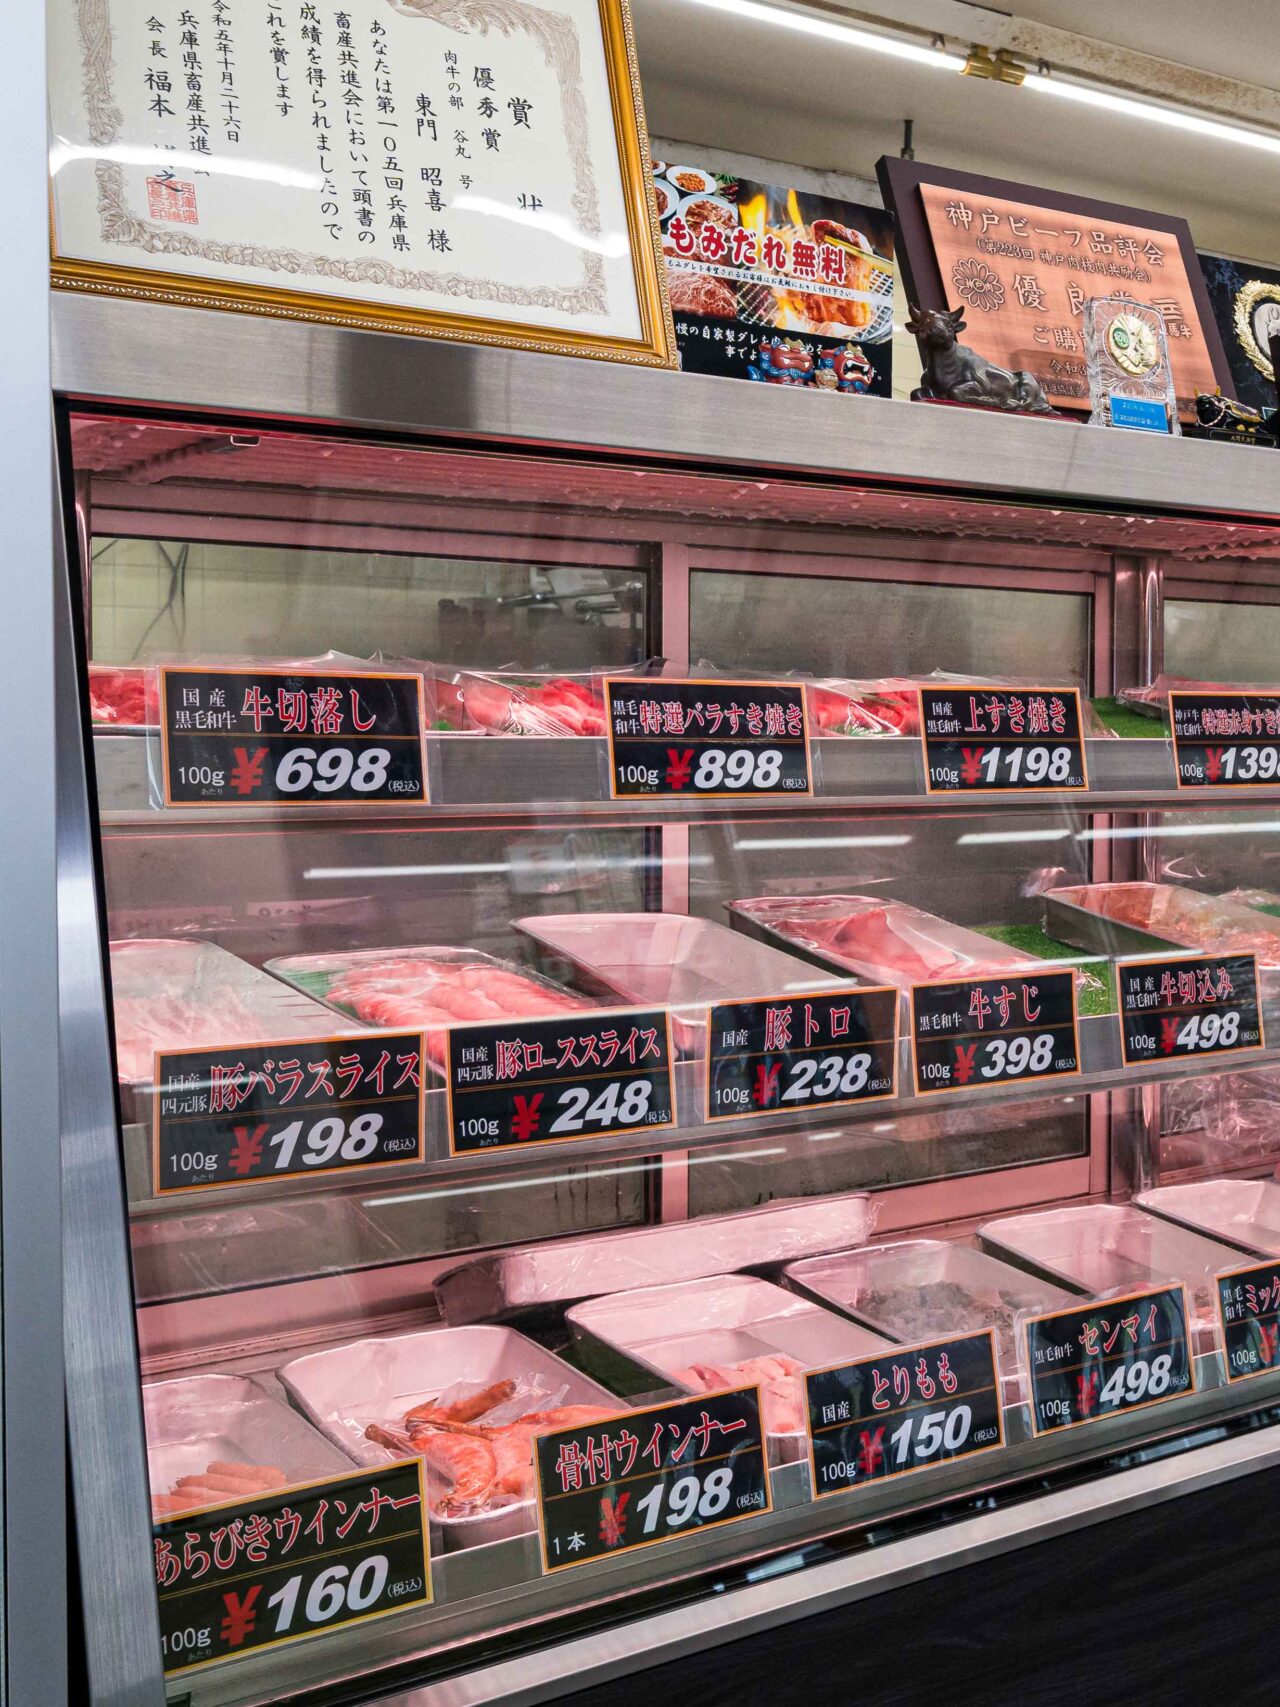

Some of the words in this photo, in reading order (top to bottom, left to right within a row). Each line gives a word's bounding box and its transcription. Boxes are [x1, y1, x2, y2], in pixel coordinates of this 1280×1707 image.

[145, 16, 167, 59] 会長
[212, 0, 241, 143] 令和五年十月二十六日
[445, 51, 464, 110] 肉牛の部
[144, 68, 176, 118] 福本
[415, 93, 438, 141] 東門
[473, 67, 501, 152] 優秀賞
[334, 11, 375, 244] 畜産共進会において頭書の
[421, 167, 447, 212] 昭喜
[427, 229, 453, 252] 様
[945, 201, 1165, 266] 神戸ビーフ品評会
[668, 217, 846, 283] もみだれ無料
[183, 688, 226, 707] 国産
[613, 700, 638, 715] 黒毛
[241, 686, 377, 734] 牛切落し
[640, 700, 803, 735] 特選バラすき焼き
[932, 702, 953, 716] 国産
[965, 697, 1066, 733] 上すき焼き
[175, 710, 237, 729] 黒毛和牛
[615, 719, 640, 735] 和牛
[928, 720, 961, 733] 黒毛和牛
[1176, 724, 1203, 736] 黒毛和牛
[179, 766, 225, 786] 100g
[618, 766, 659, 784] 100g
[1180, 764, 1203, 778] 100g
[1130, 977, 1154, 992] 国産
[1160, 966, 1233, 1006] 牛切込み
[968, 985, 1041, 1030] 牛すじ
[1127, 991, 1160, 1008] 黒毛和牛
[764, 1004, 850, 1051] 豚トロ
[920, 1012, 962, 1031] 黒毛和牛
[722, 1029, 748, 1047] 国産
[1130, 1035, 1156, 1049] 100g
[462, 1047, 488, 1063] 国産
[496, 1027, 660, 1080] 豚ローススライス
[210, 1050, 420, 1113] 豚バラスライス
[457, 1065, 495, 1082] 四元豚
[921, 1064, 950, 1080] 100g
[168, 1073, 200, 1093] 国産
[163, 1095, 207, 1115] 四元豚
[716, 1087, 749, 1104] 100g
[460, 1118, 499, 1137] 100g
[170, 1152, 217, 1173] 100g
[1223, 1286, 1244, 1303] 黒毛
[1225, 1304, 1245, 1320] 和牛
[1079, 1304, 1157, 1355] センマイ
[1035, 1343, 1074, 1364] 黒毛和牛
[1231, 1351, 1257, 1366] 100g
[872, 1353, 957, 1410] とりもも
[823, 1401, 850, 1423] 国産
[1040, 1400, 1070, 1418] 100g
[556, 1412, 746, 1492] 骨付ウインナー
[821, 1462, 856, 1481] 100g
[155, 1487, 420, 1586] あらびきウインナー
